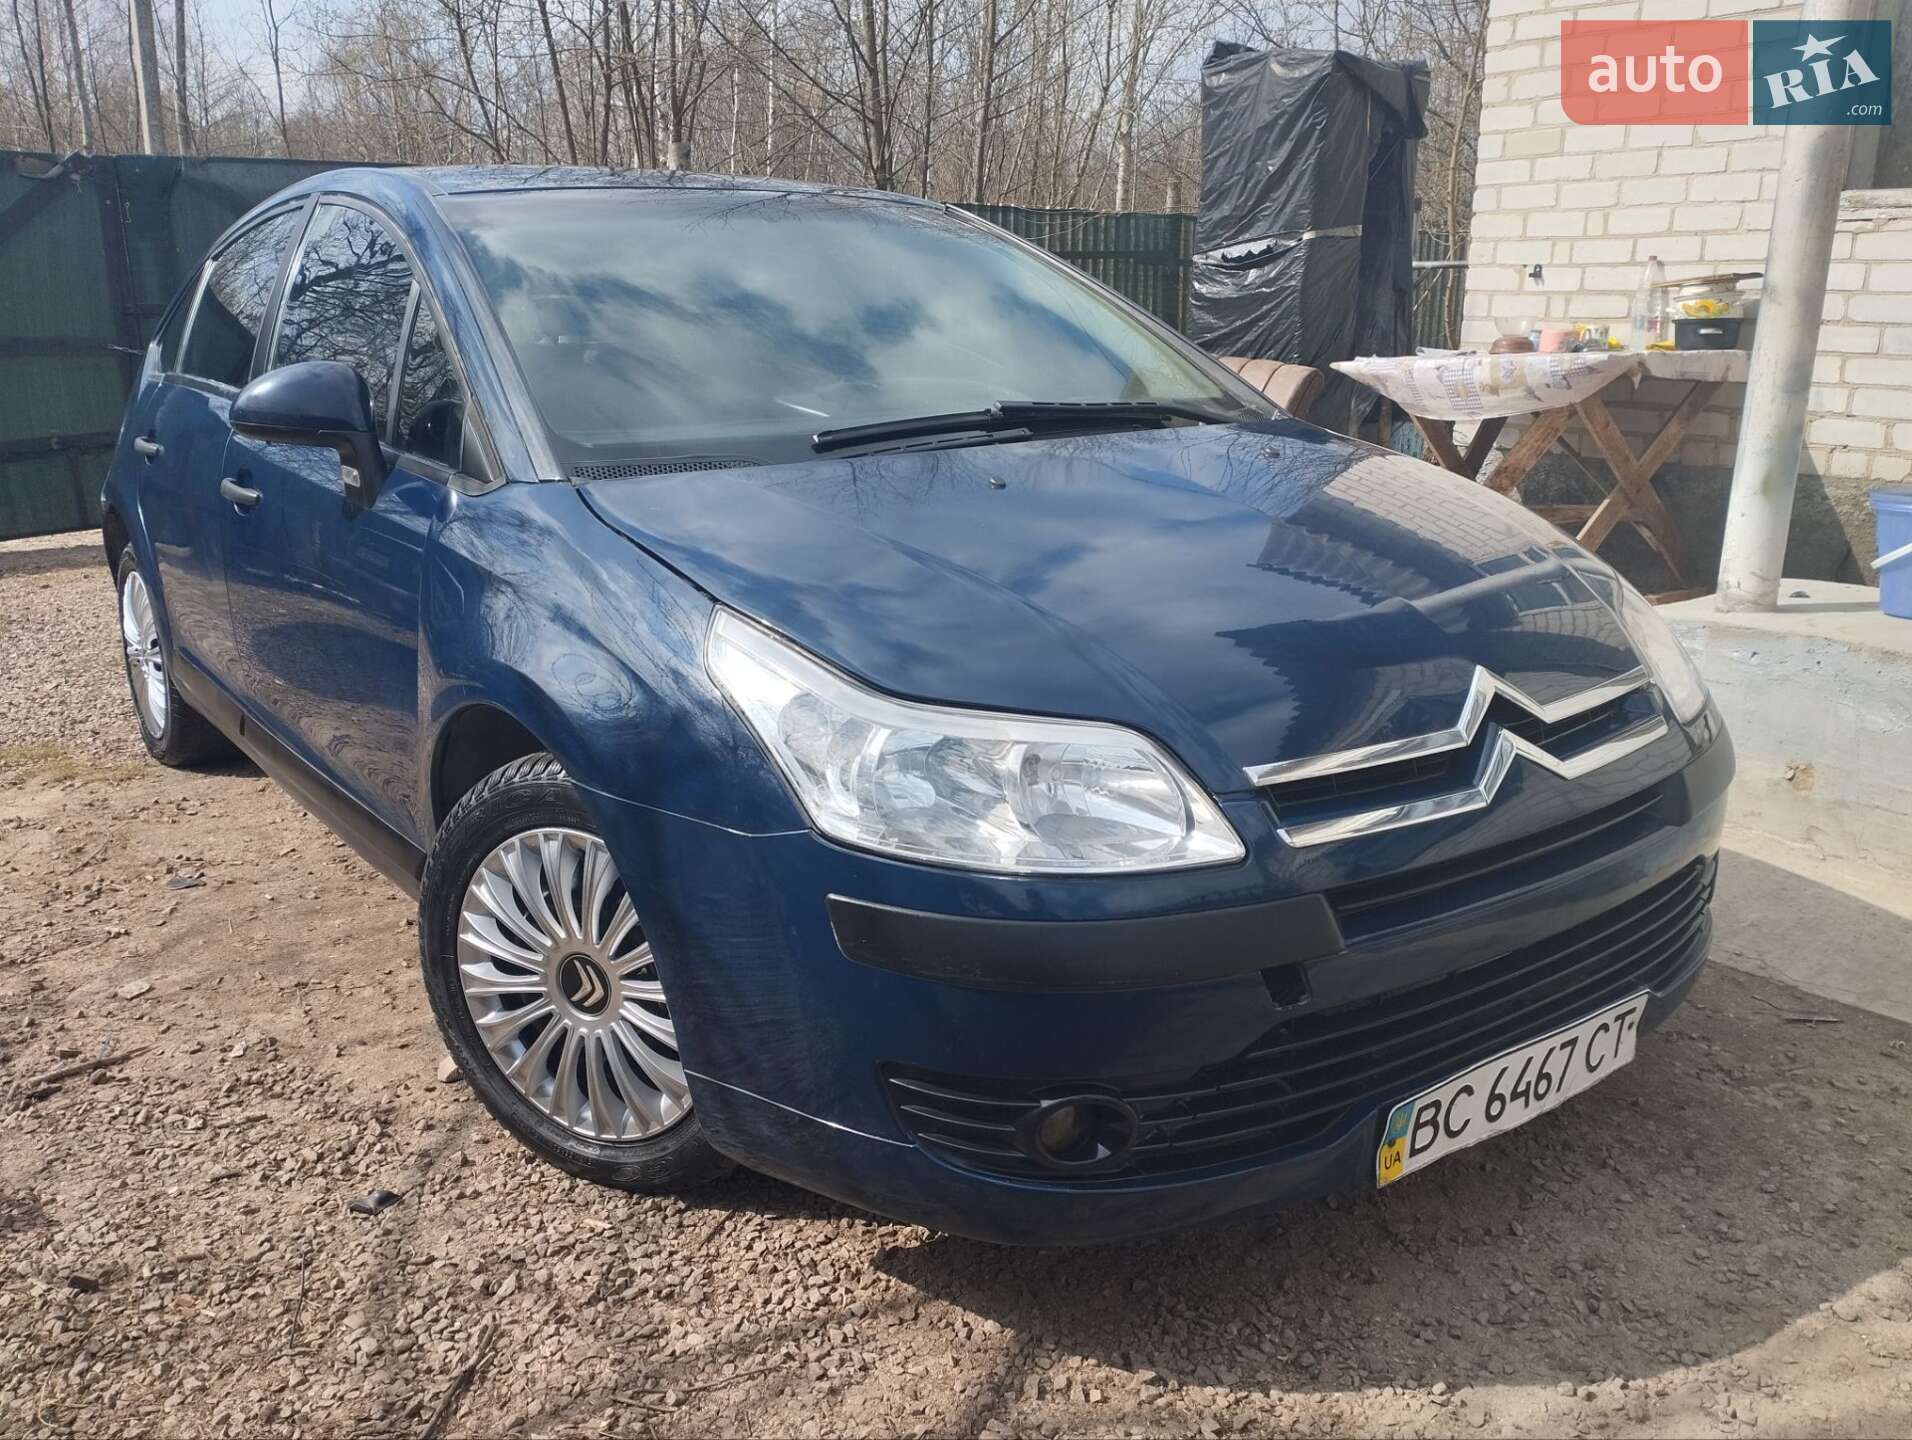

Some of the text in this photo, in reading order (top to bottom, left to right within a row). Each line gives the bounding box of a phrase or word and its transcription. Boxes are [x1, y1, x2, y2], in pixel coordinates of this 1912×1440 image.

[1408, 1006, 1637, 1158] BC 6467 CT
[1384, 1151, 1401, 1170] UA
